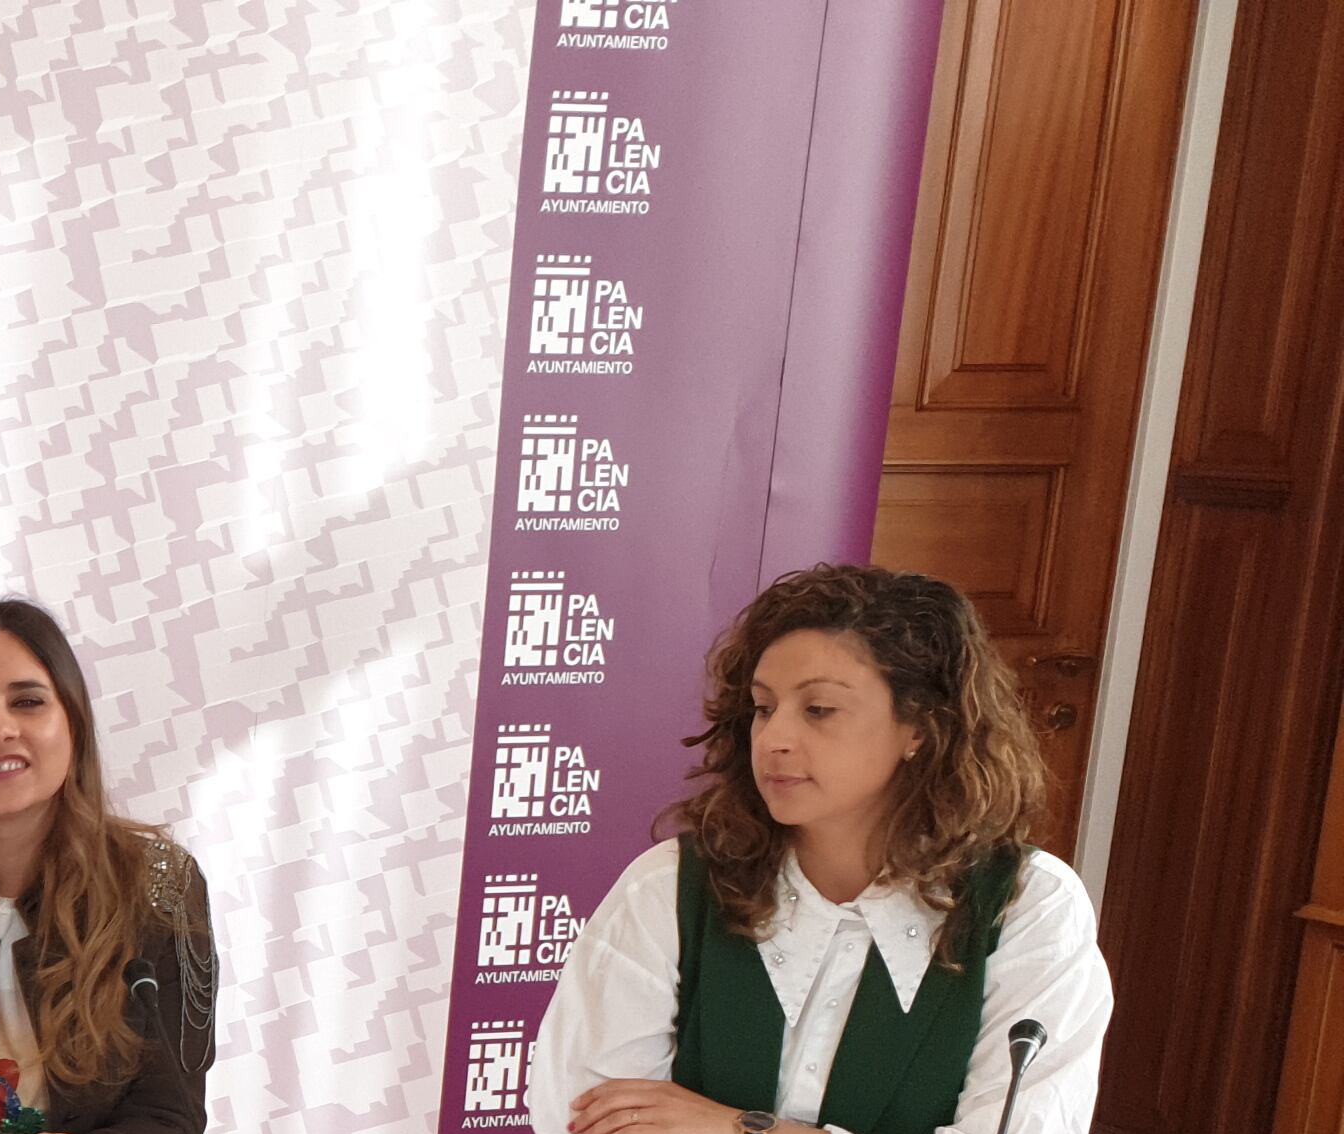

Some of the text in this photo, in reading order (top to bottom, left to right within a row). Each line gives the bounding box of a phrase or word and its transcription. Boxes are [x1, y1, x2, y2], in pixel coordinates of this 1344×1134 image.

[624, 4, 669, 29] CIA
[557, 34, 668, 49] AYUNTAMIENTO
[611, 118, 645, 141] PA
[608, 144, 661, 169] LEN
[605, 171, 650, 194] CIA
[540, 200, 649, 214] AYUNTAMIENTO
[594, 281, 627, 303] PA
[592, 306, 643, 329] LEN
[589, 333, 633, 355] CIA
[527, 360, 632, 374] AYUNTAMIENTO
[581, 439, 613, 461] PA
[579, 464, 629, 487] LEN
[577, 490, 620, 512] CIA
[515, 518, 620, 531] AYUNTAMIENTO
[567, 595, 599, 616] PA
[565, 619, 614, 641] LEN
[563, 644, 605, 666] CIA
[501, 672, 604, 685] AYUNTAMIENTO
[554, 747, 585, 768] PA
[552, 770, 599, 792] LEN
[550, 794, 591, 816] CIA
[488, 822, 590, 836] AYUNTAMIENTO
[540, 895, 571, 916] PA
[539, 918, 586, 941] LEN
[475, 969, 563, 984] AYUNTAMIEN
[462, 1114, 534, 1128] AYUNTAMI
